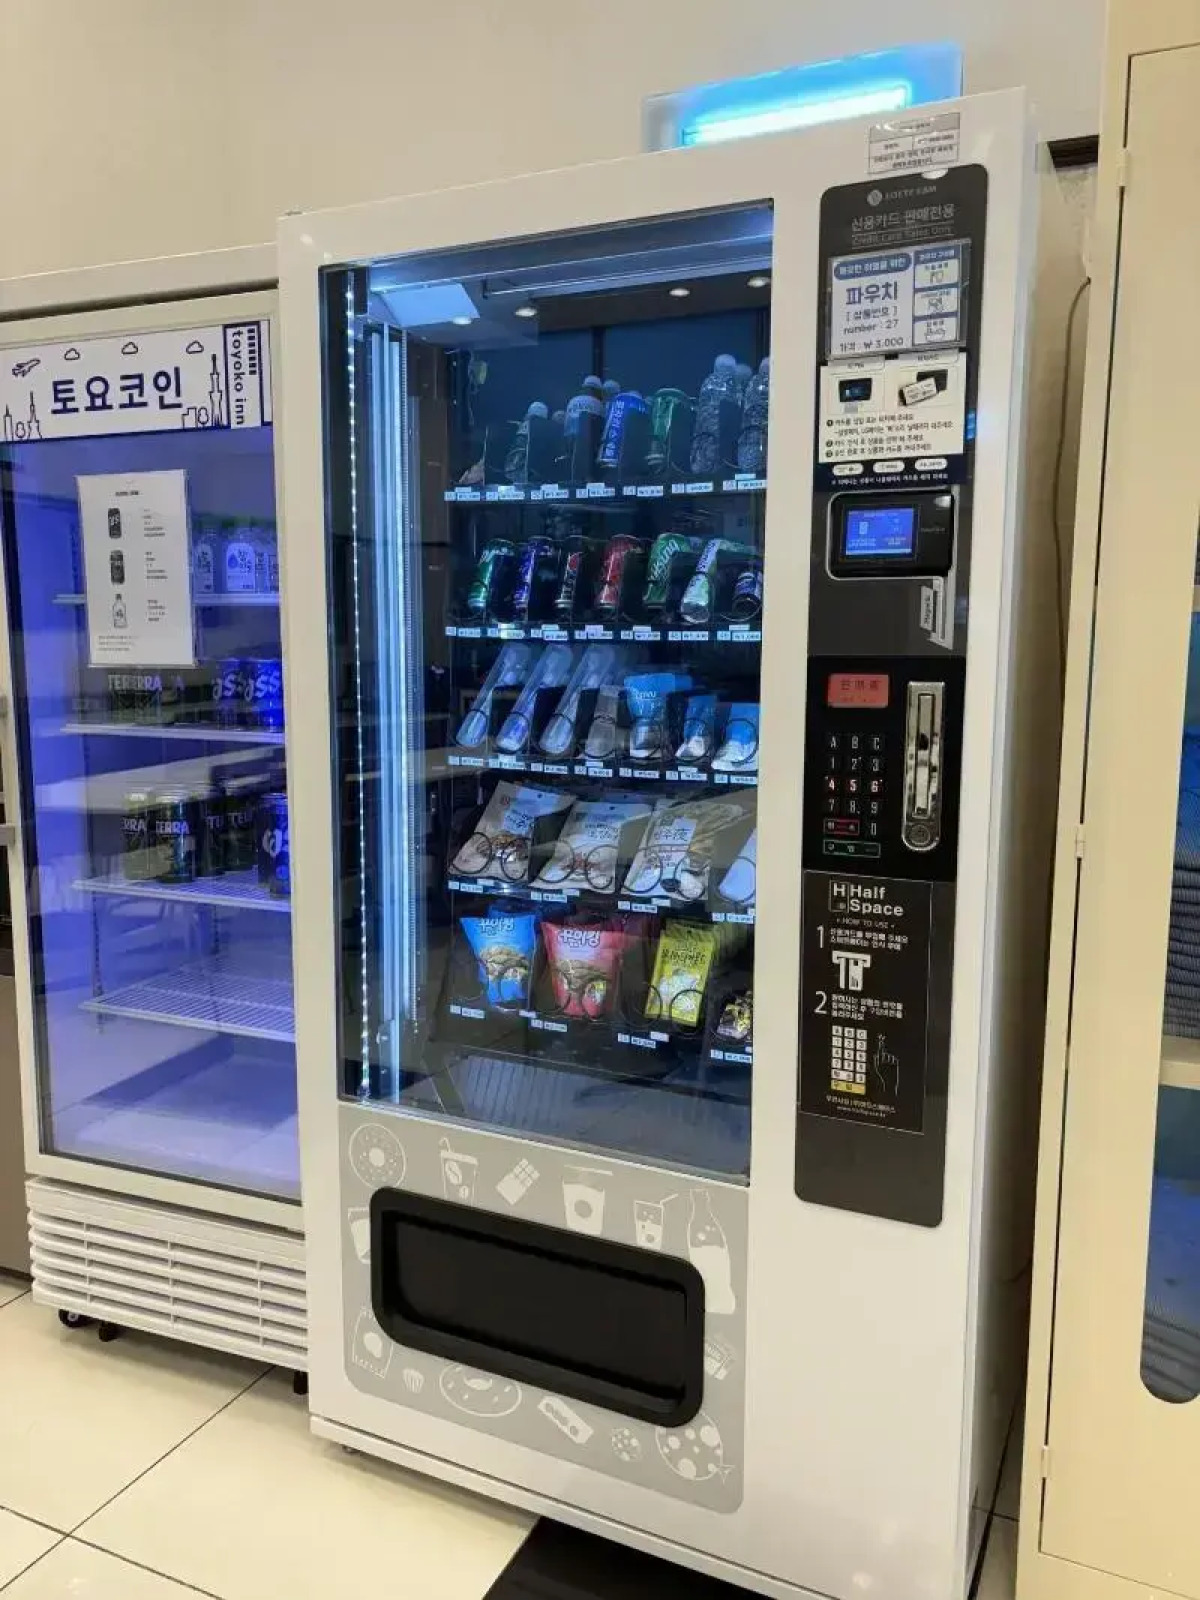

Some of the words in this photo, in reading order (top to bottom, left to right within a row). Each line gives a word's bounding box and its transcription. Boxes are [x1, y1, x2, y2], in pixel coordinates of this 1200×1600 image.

[845, 281, 899, 306] 파우치
[843, 323, 878, 336] number
[885, 319, 900, 331] 27
[231, 329, 247, 394] toyoko
[51, 366, 184, 415] 토요코인
[232, 397, 245, 426] inn
[833, 882, 846, 898] H
[850, 883, 886, 900] Half
[850, 899, 904, 917] Space
[817, 925, 824, 949] 1
[814, 990, 828, 1015] 2
